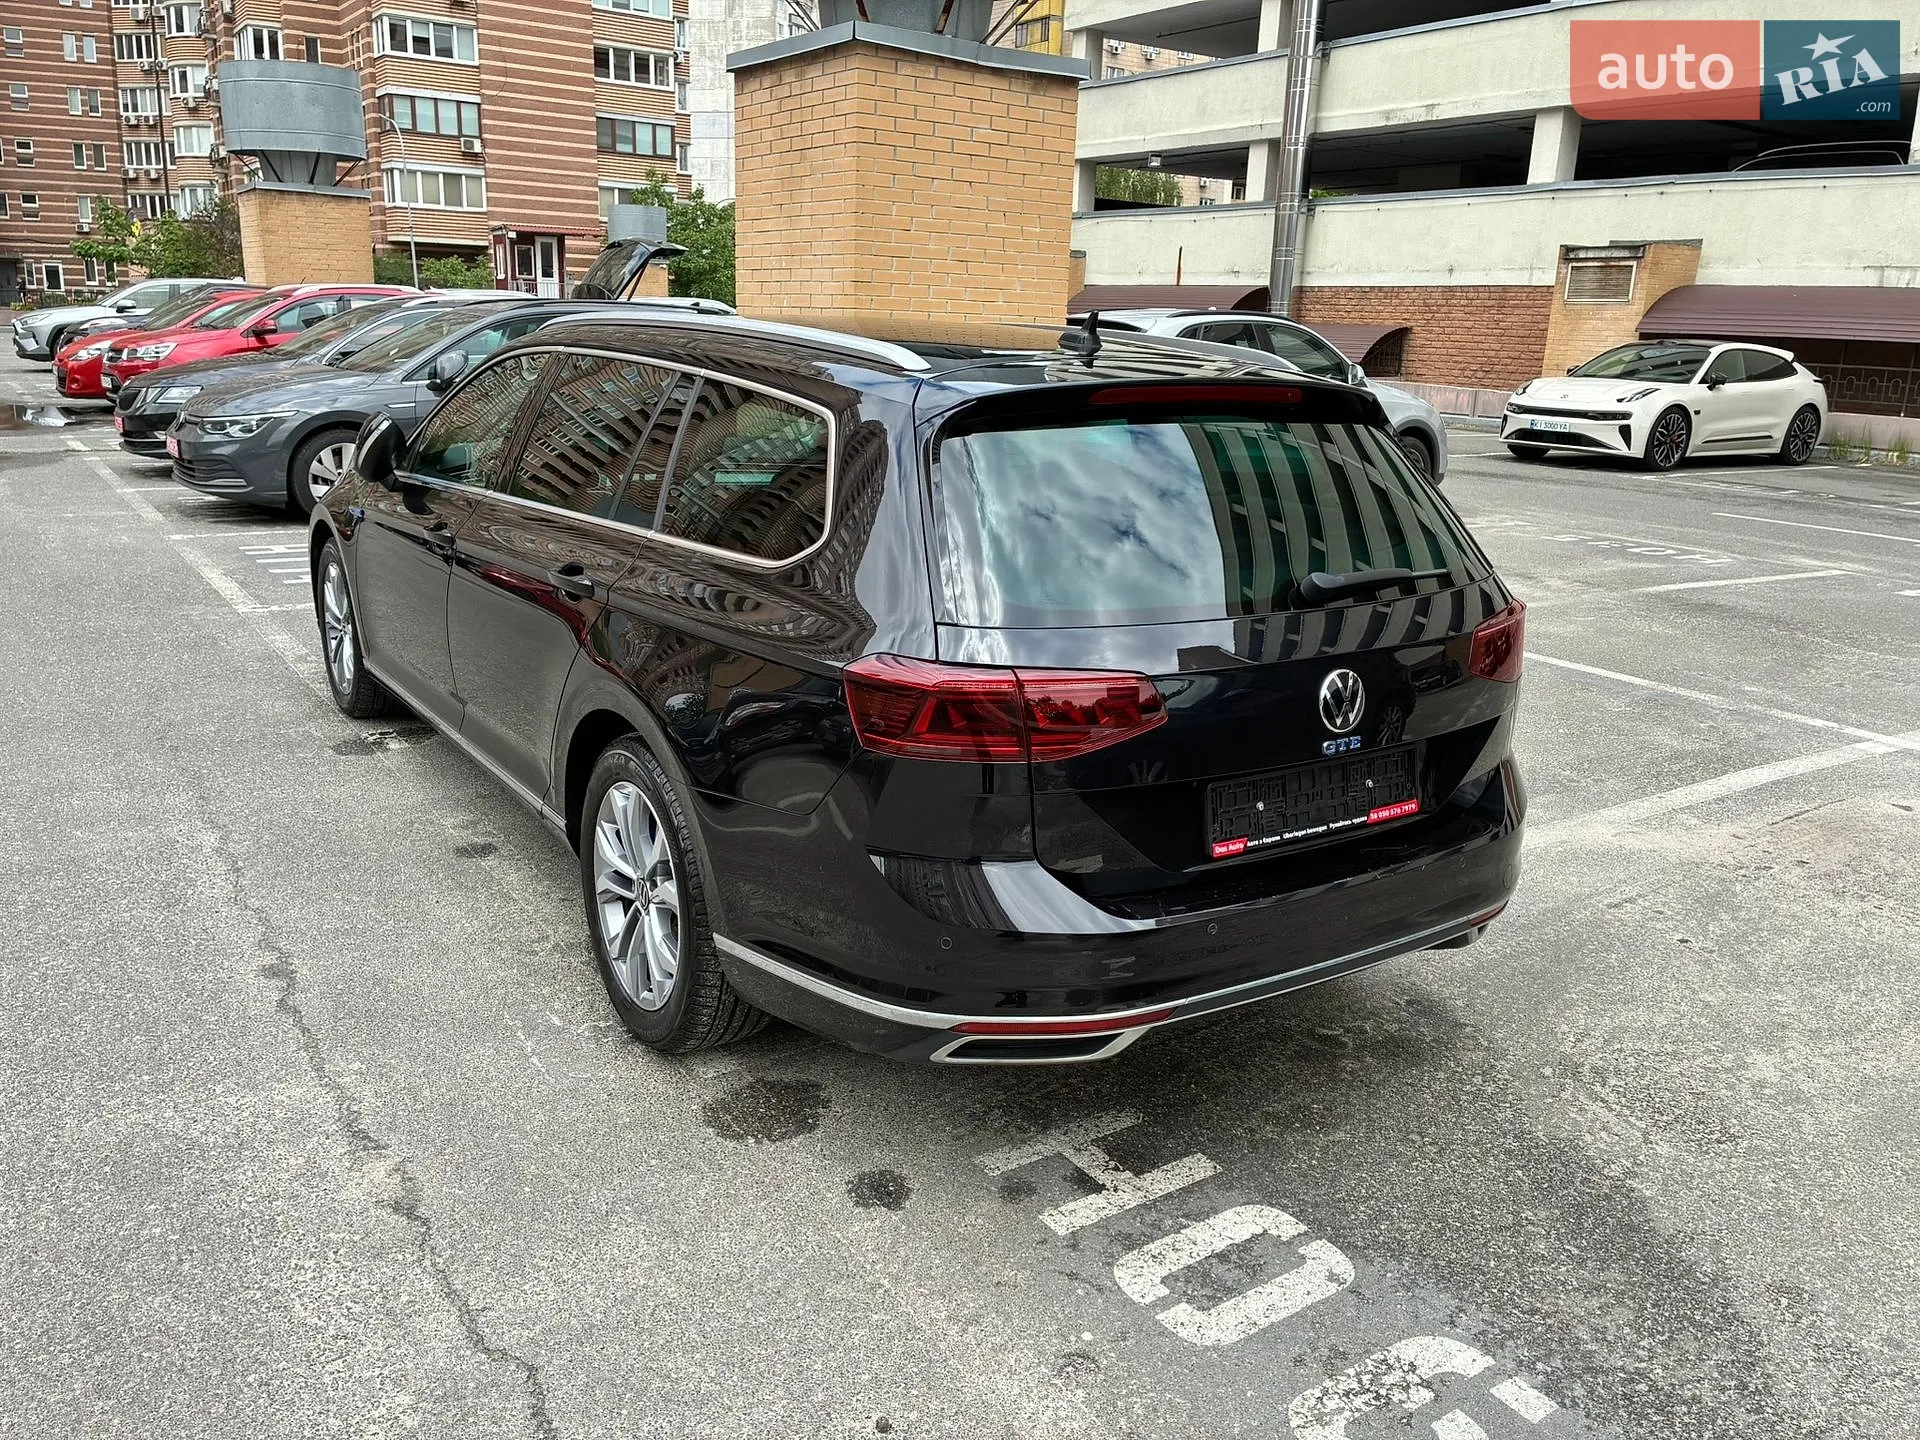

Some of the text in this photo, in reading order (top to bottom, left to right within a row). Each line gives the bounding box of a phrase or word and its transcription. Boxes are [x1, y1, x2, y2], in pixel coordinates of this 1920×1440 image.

[1322, 736, 1361, 755] GTE
[1215, 842, 1245, 854] Das Auto
